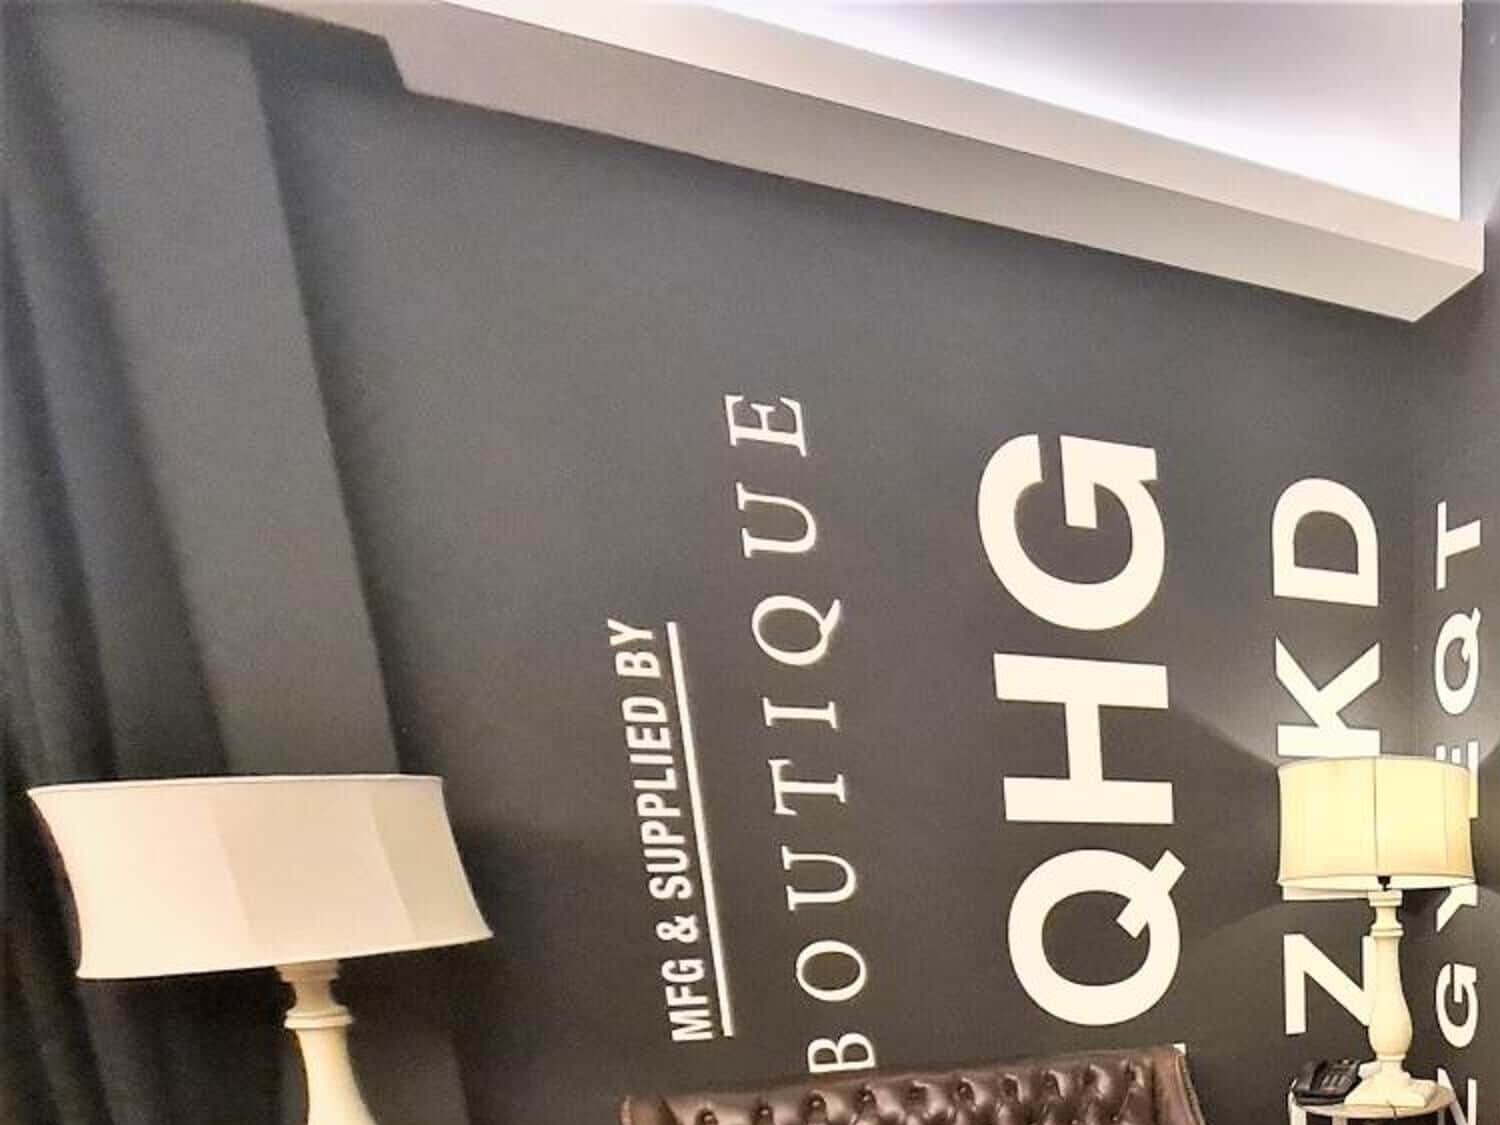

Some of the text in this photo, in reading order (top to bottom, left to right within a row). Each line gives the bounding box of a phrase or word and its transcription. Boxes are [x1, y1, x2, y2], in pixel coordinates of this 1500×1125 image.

[607, 618, 714, 1042] MFG & SUPPLIED BY
[725, 394, 876, 1074] BOUTIQUE
[978, 433, 1186, 1054] QHG
